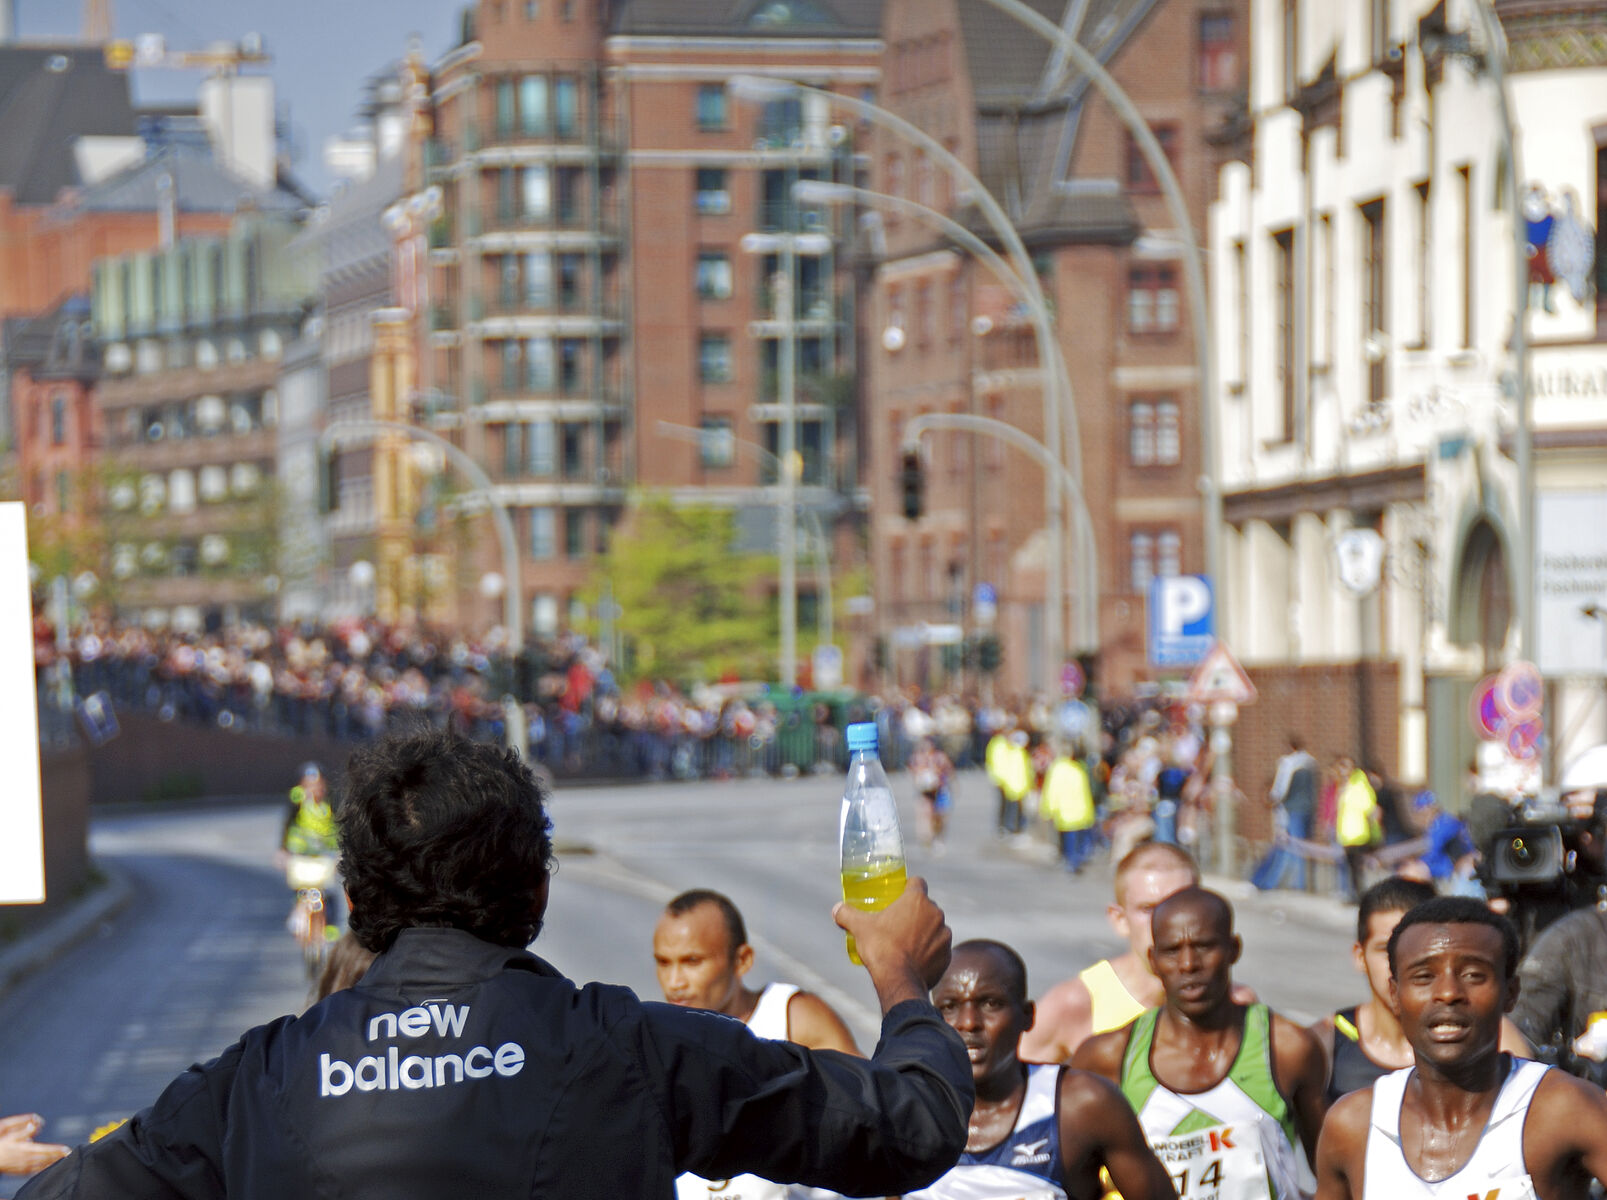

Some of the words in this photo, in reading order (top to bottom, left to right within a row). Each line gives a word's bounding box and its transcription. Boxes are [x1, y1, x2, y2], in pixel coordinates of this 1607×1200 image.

[1161, 576, 1211, 636] P
[369, 1004, 470, 1041] new
[320, 1042, 525, 1096] balance
[1171, 1158, 1225, 1196] 14
